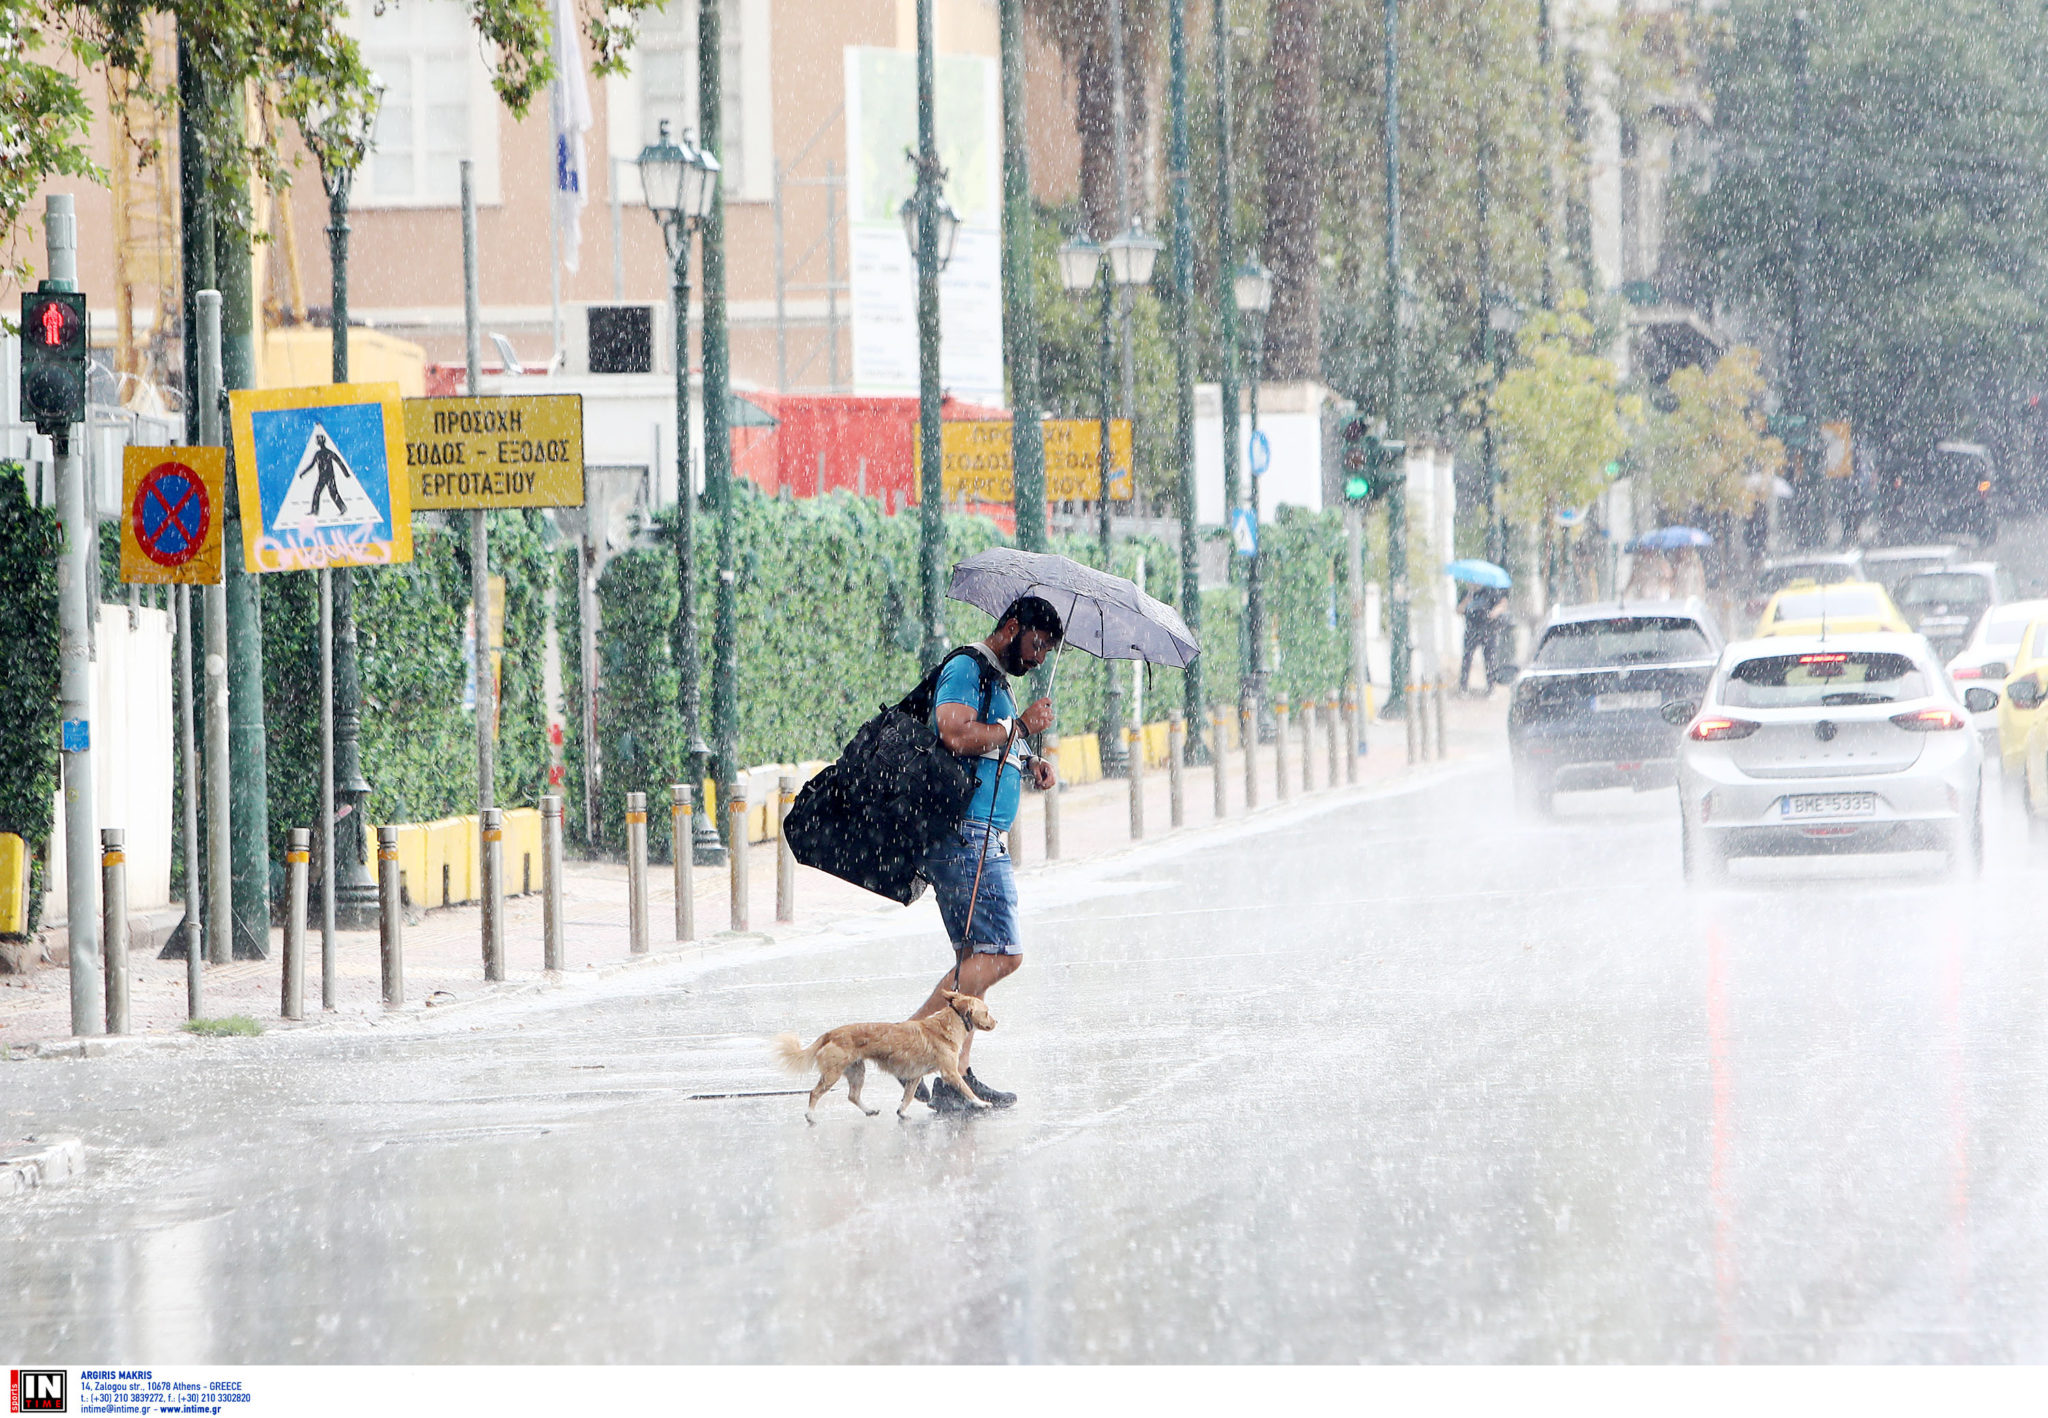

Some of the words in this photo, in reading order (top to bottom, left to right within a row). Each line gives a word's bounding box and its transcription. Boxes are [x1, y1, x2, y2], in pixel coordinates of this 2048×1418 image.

[434, 410, 522, 434] ΠΡΟΣΟΧΗ
[972, 426, 1071, 444] ΠΡΟΧΗ
[406, 442, 466, 466] ΣΟΔΟΣ
[498, 439, 570, 464] ΕΞΟΔΟΣ
[944, 452, 1013, 471] ΣΟΔΟΣ
[422, 471, 536, 496] ΕΡΓΟΤΑΞΙΟΥ
